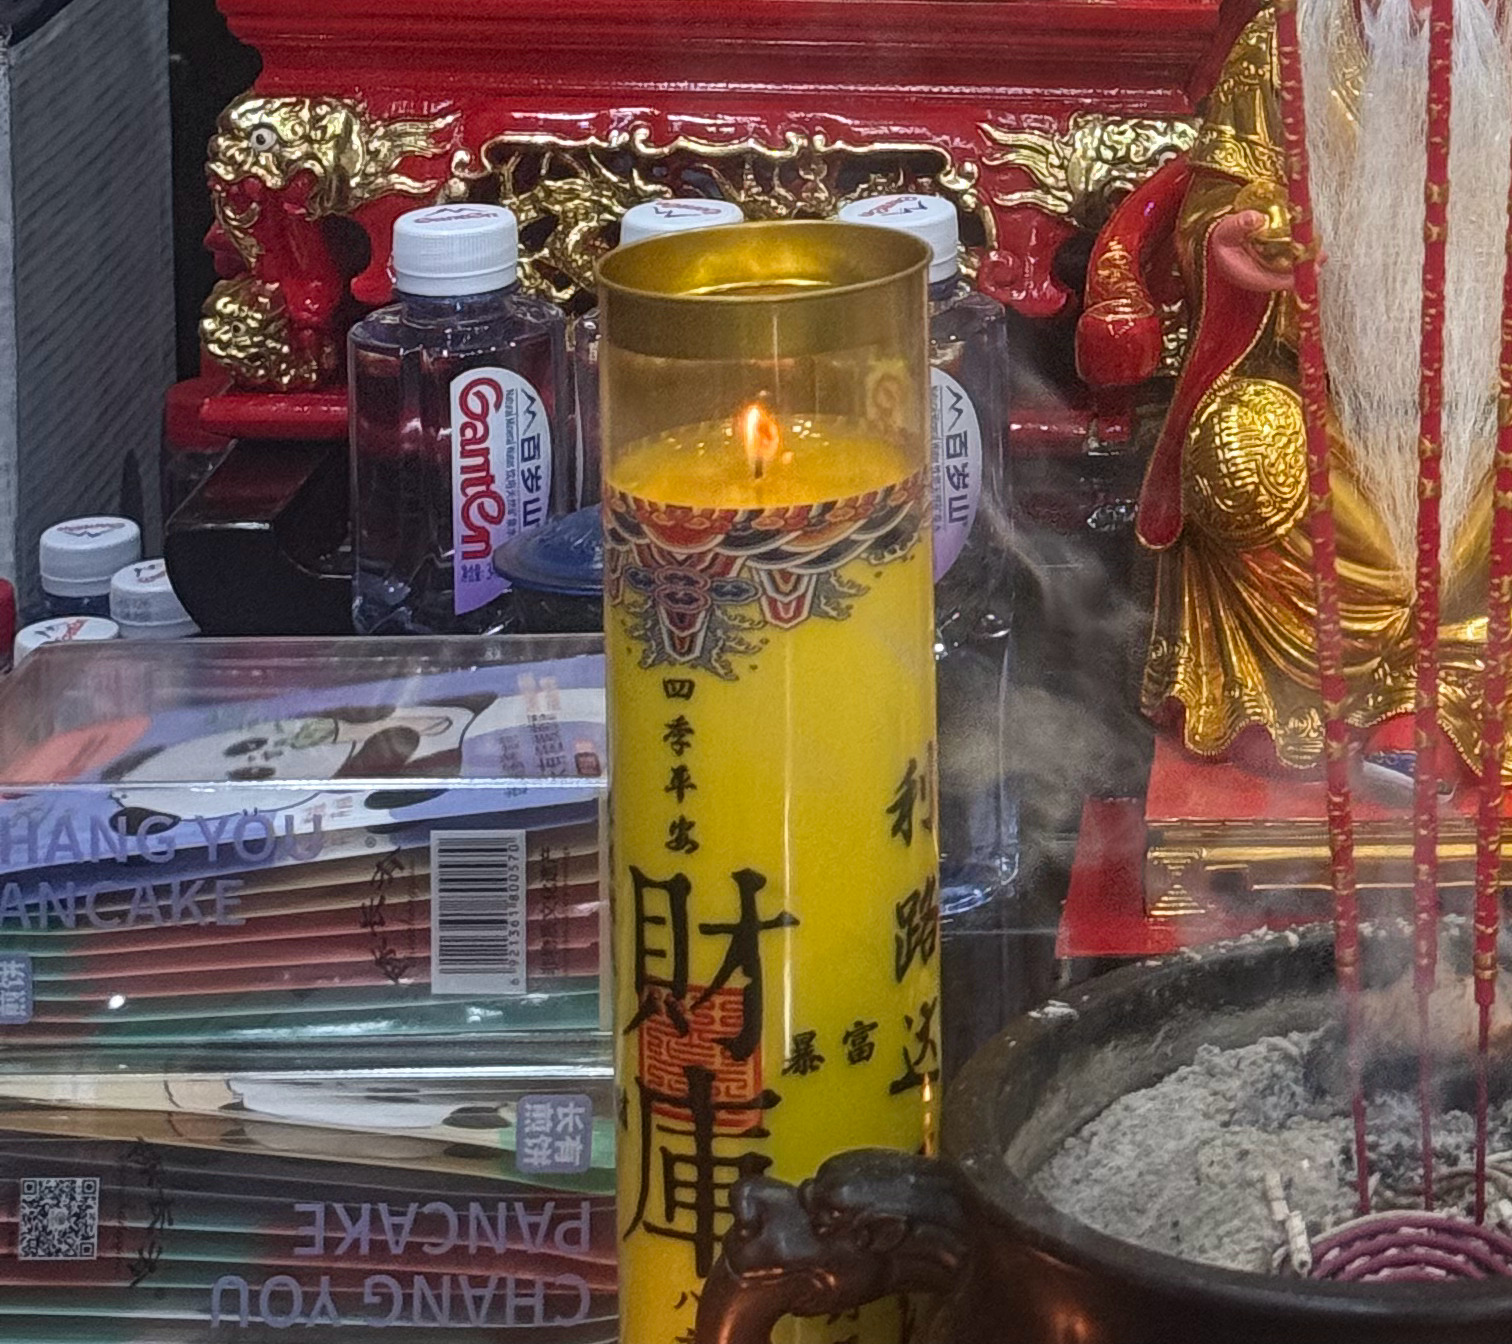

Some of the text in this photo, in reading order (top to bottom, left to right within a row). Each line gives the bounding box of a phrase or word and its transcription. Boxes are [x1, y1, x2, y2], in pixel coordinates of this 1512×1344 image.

[520, 432, 543, 528] 百岁山
[945, 430, 970, 525] 百岁山
[661, 677, 700, 854] 四季平安
[507, 843, 520, 903] 800570
[623, 864, 800, 1279] 財庫
[781, 1018, 879, 1077] 暴富
[522, 1102, 555, 1167] 煎饼
[555, 1100, 586, 1167] 长有
[293, 1200, 592, 1256] PANCAKE
[209, 1273, 592, 1329] CHANG YOU
